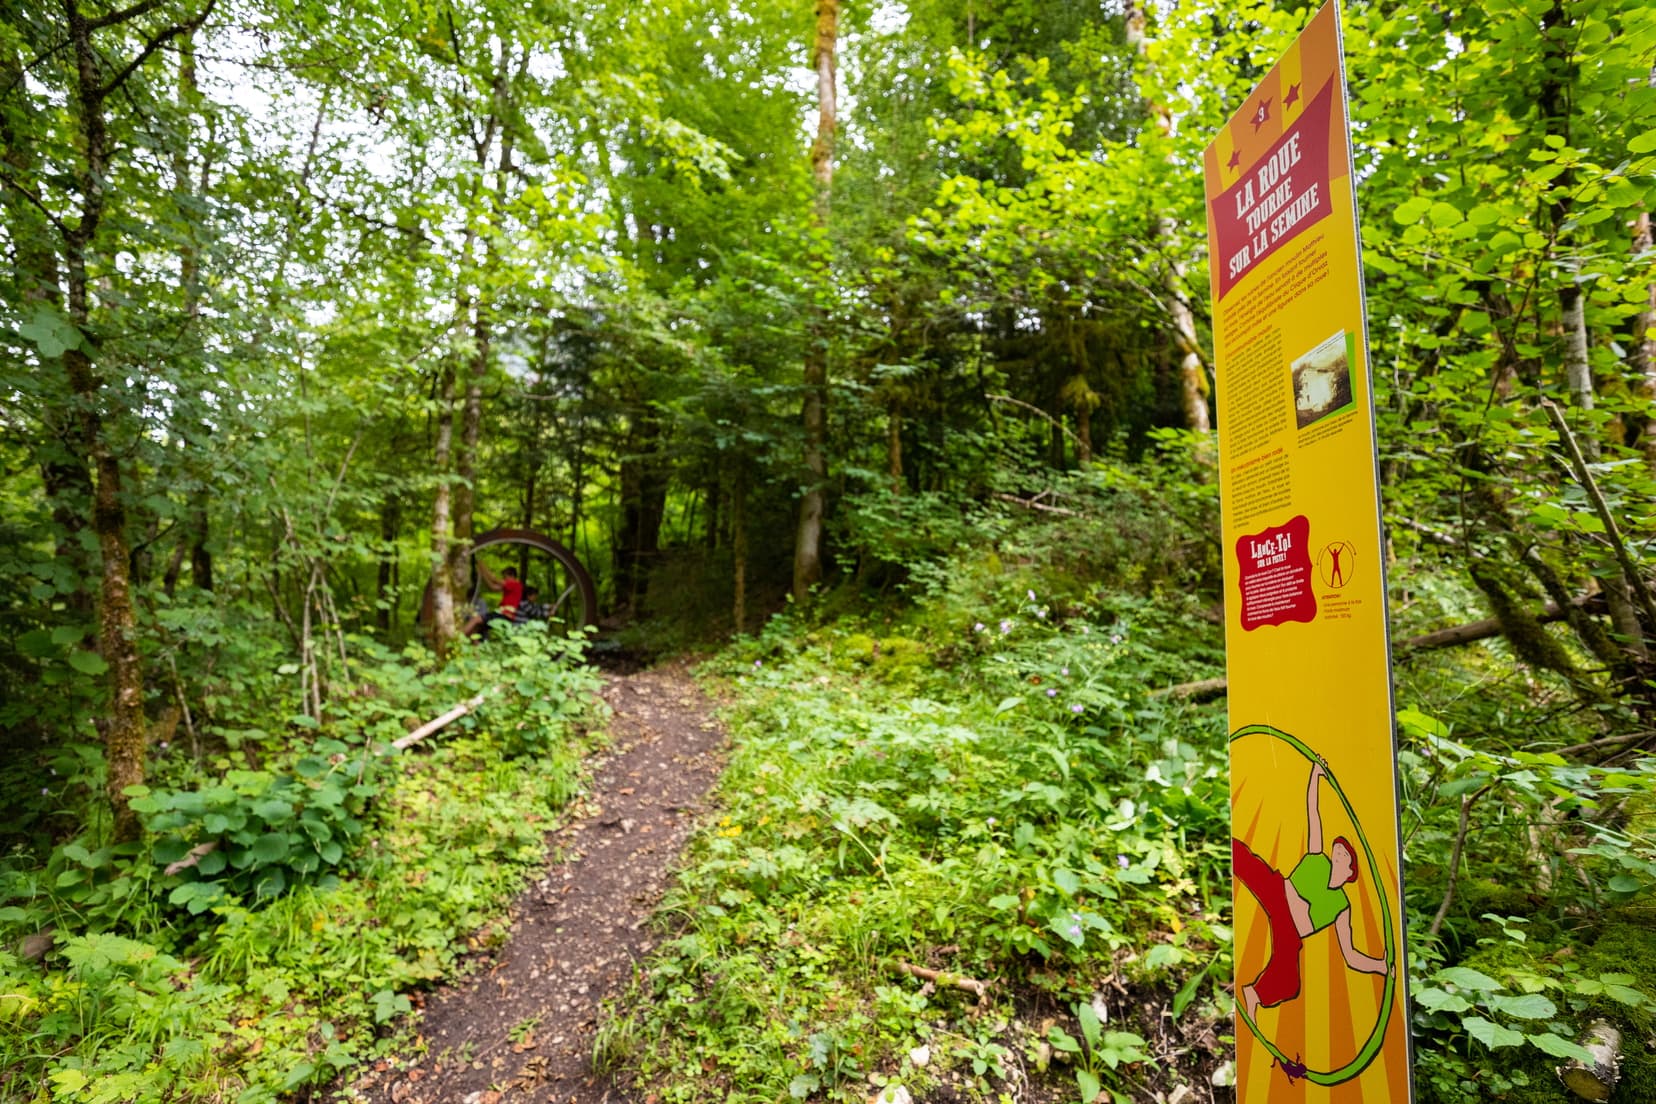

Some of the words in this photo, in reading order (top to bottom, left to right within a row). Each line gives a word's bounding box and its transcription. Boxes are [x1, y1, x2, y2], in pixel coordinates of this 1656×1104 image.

[1235, 179, 1255, 219] LA
[1257, 131, 1301, 197] ROUE
[1246, 176, 1293, 236] TOURNE
[1229, 245, 1251, 279] SUR
[1252, 229, 1268, 259] LA
[1270, 182, 1319, 243] SEMINE
[1250, 532, 1292, 560] LANCE-TOI
